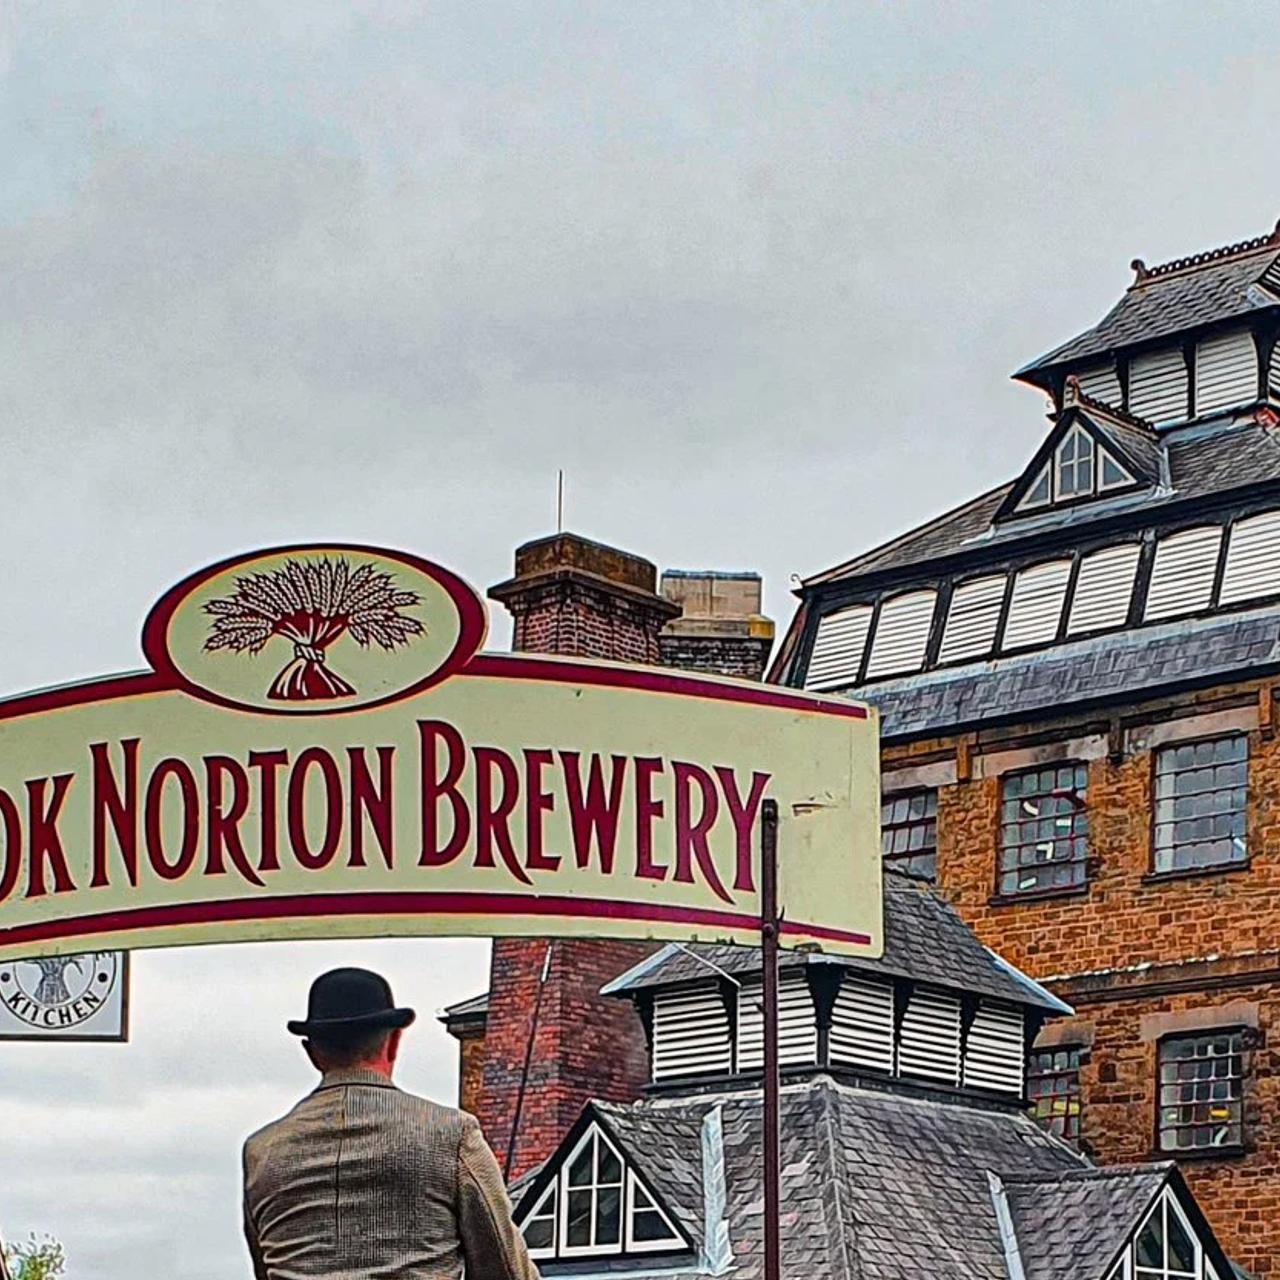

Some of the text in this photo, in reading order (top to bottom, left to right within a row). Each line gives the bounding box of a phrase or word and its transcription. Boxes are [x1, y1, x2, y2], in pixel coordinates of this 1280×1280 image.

[90, 738, 396, 888] NORTON
[417, 720, 771, 905] BREWERY
[6, 989, 101, 1026] KITCHEN
